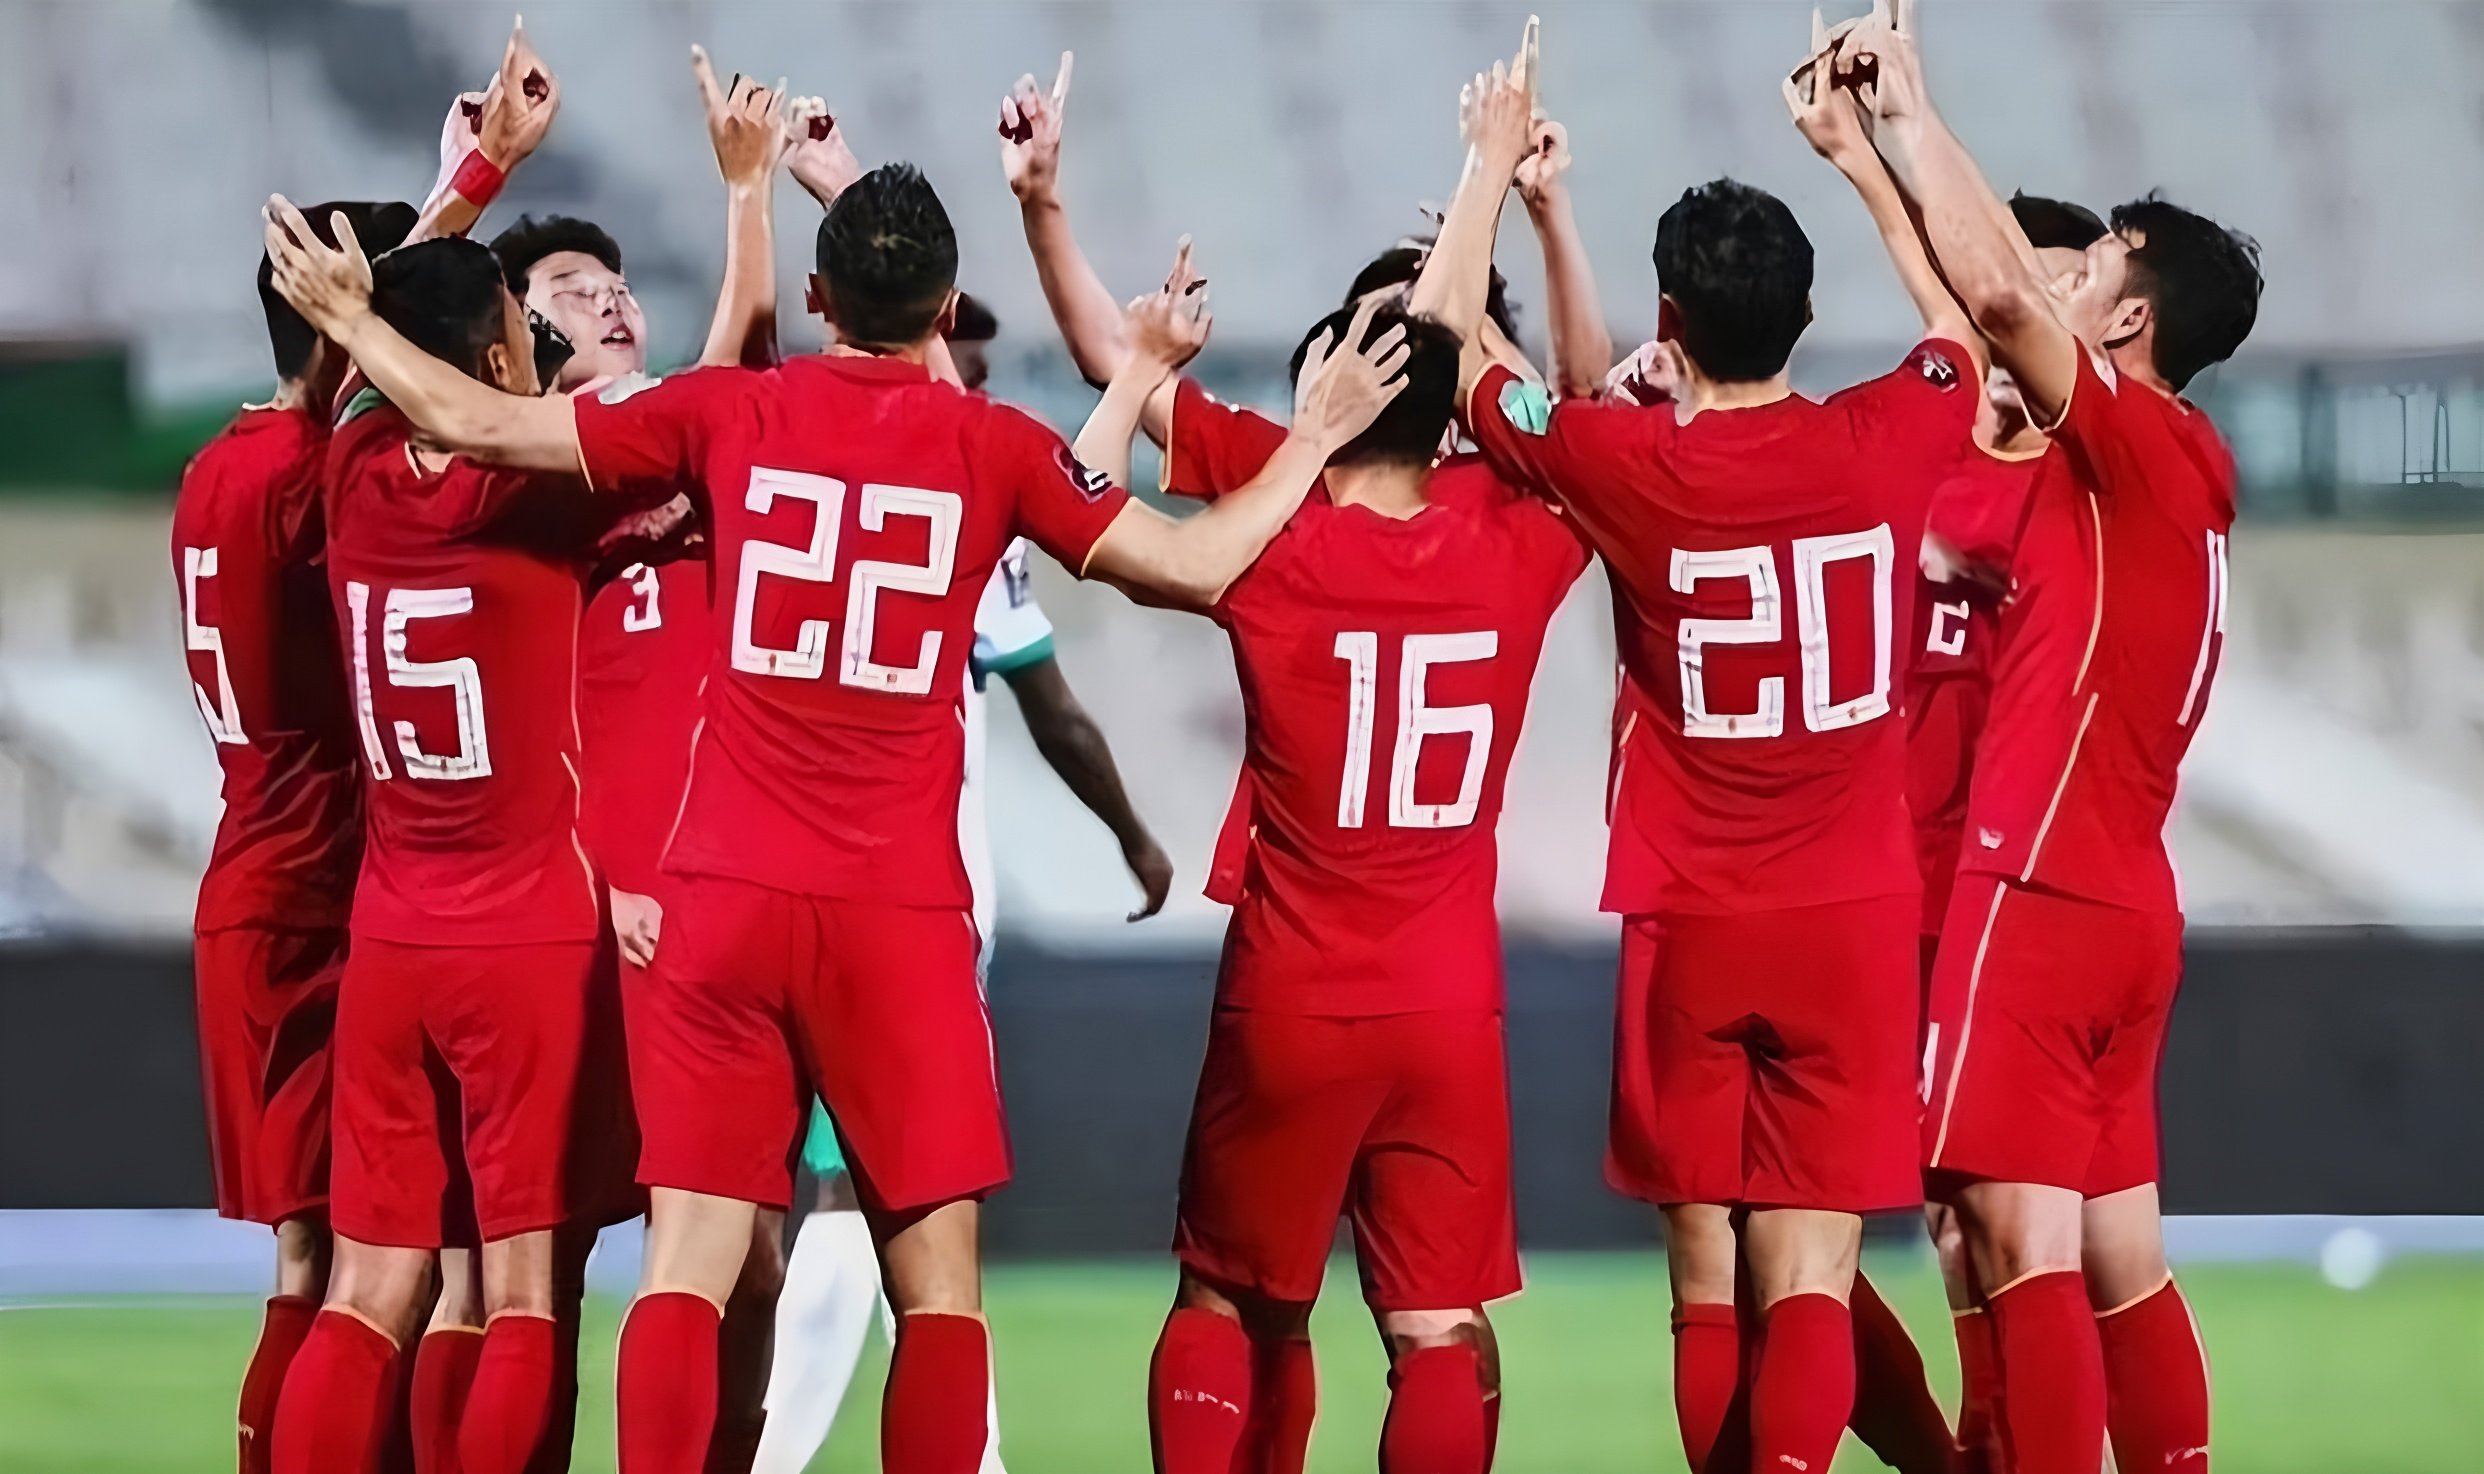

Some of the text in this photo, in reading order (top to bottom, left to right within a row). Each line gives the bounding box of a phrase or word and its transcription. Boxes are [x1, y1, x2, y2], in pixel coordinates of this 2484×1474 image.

[347, 581, 492, 781] 15
[731, 466, 963, 695] 22
[1669, 523, 1894, 738] 20
[1334, 630, 1498, 828] 16
